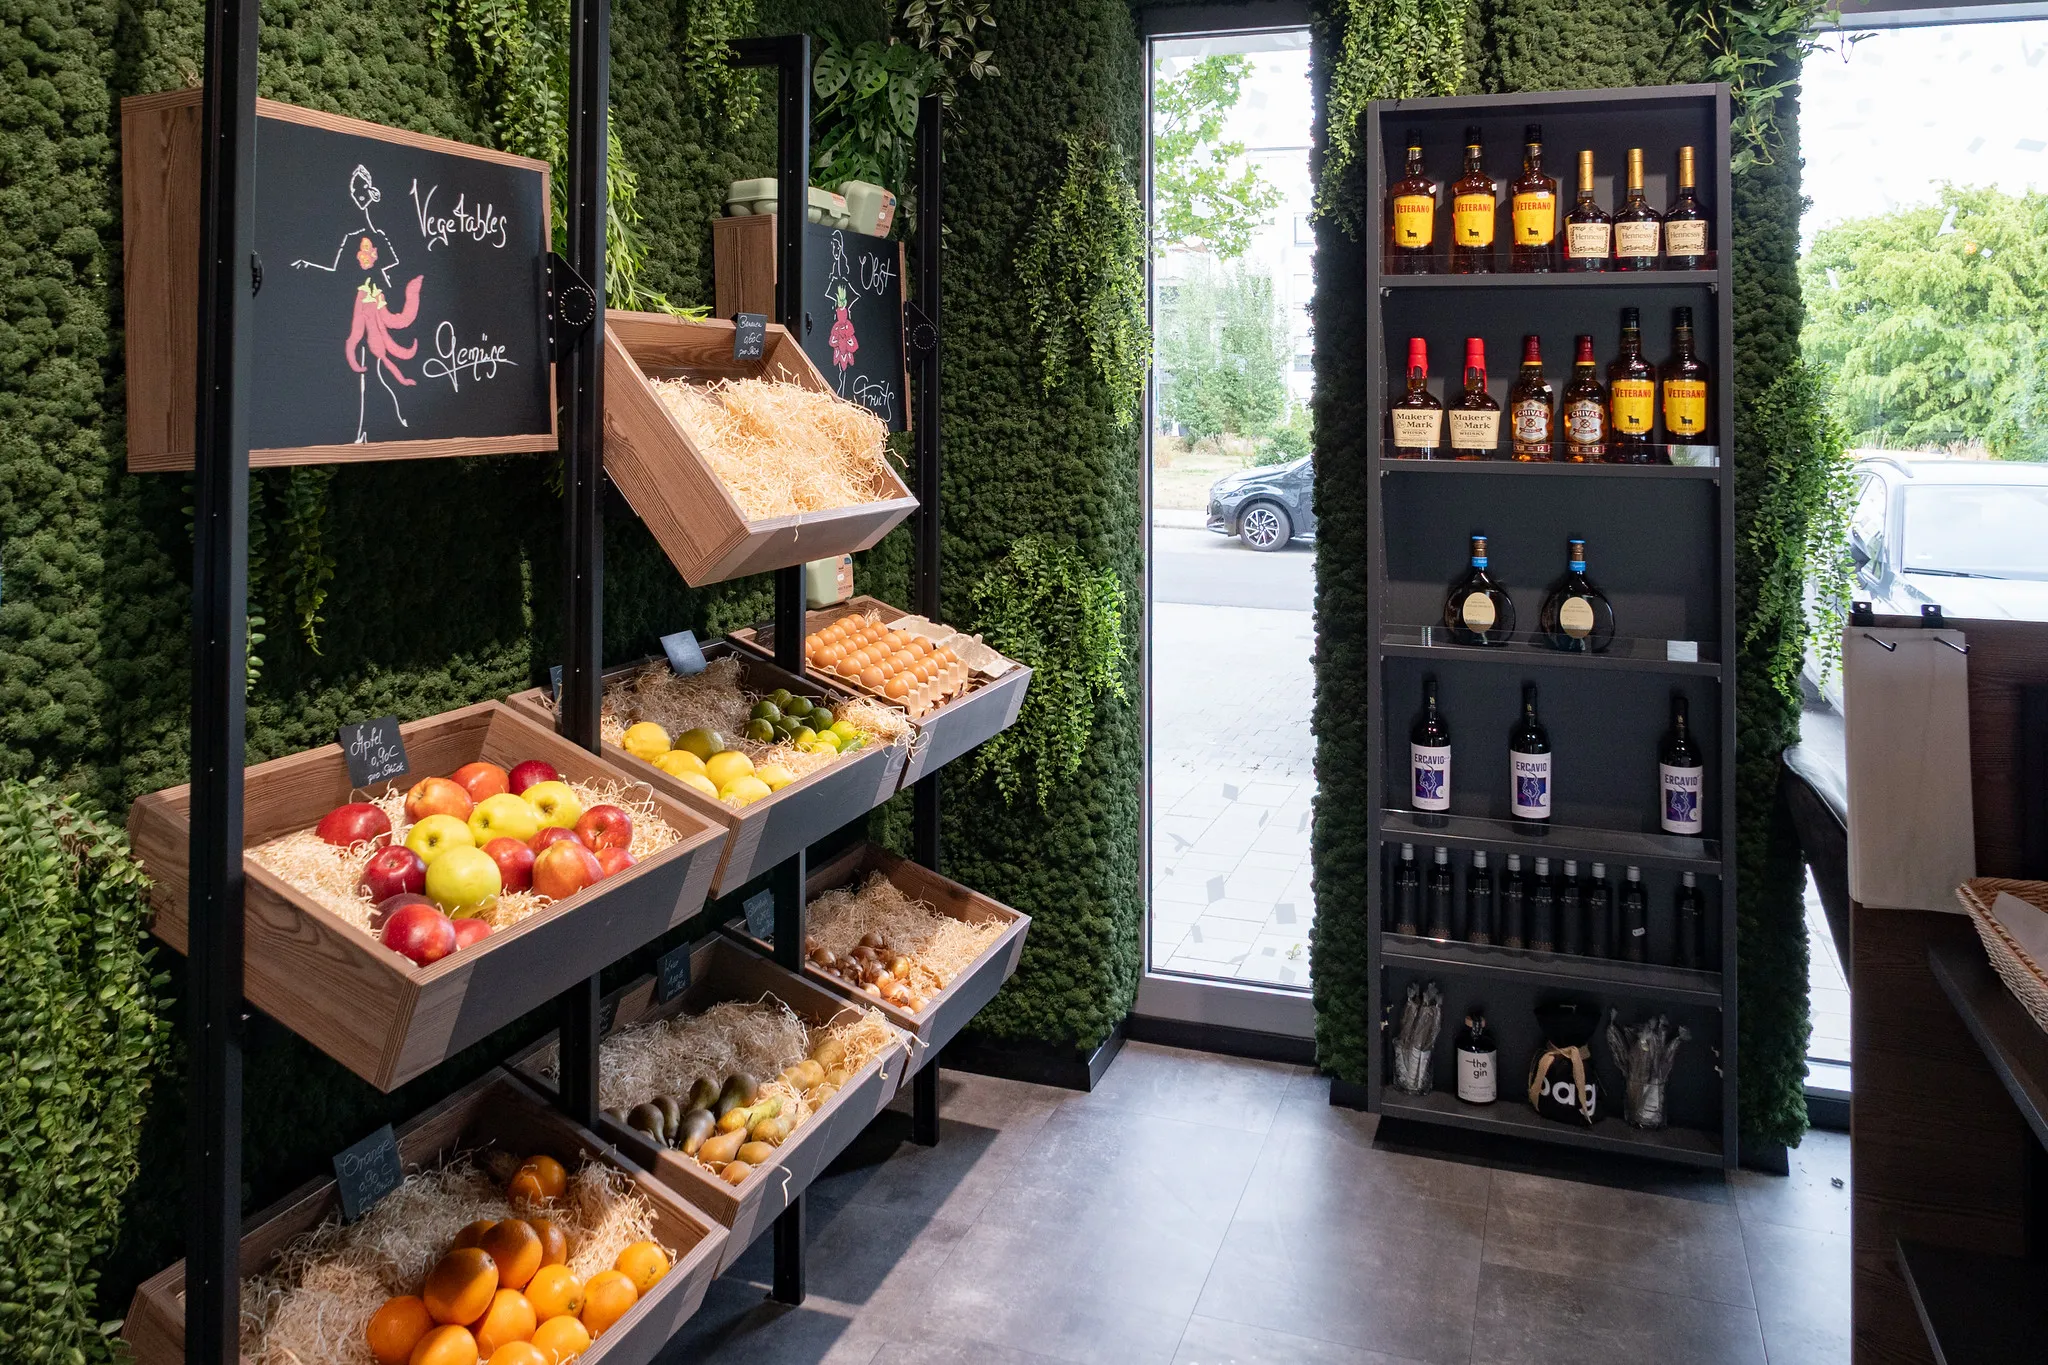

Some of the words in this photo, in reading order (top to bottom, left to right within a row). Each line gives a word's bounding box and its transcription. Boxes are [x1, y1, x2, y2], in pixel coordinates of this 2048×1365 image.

[1396, 203, 1430, 214] VETERANO
[1457, 202, 1491, 213] VETERANO
[1516, 200, 1551, 211] VETERANO
[409, 178, 508, 252] Vegetables
[858, 252, 897, 295] Obst
[423, 320, 520, 393] Gemüse
[1615, 387, 1651, 398] VETERANO
[1668, 388, 1705, 398] VETERANO
[852, 375, 895, 422] Fruits
[1571, 410, 1599, 418] CHIVAS
[1415, 753, 1445, 765] ERCAVIO
[1516, 760, 1547, 772] ERCAVIO
[1664, 774, 1698, 786] ERCAVIO
[1467, 1058, 1487, 1068] the
[1473, 1069, 1488, 1079] gin
[340, 1139, 395, 1176] Orange
